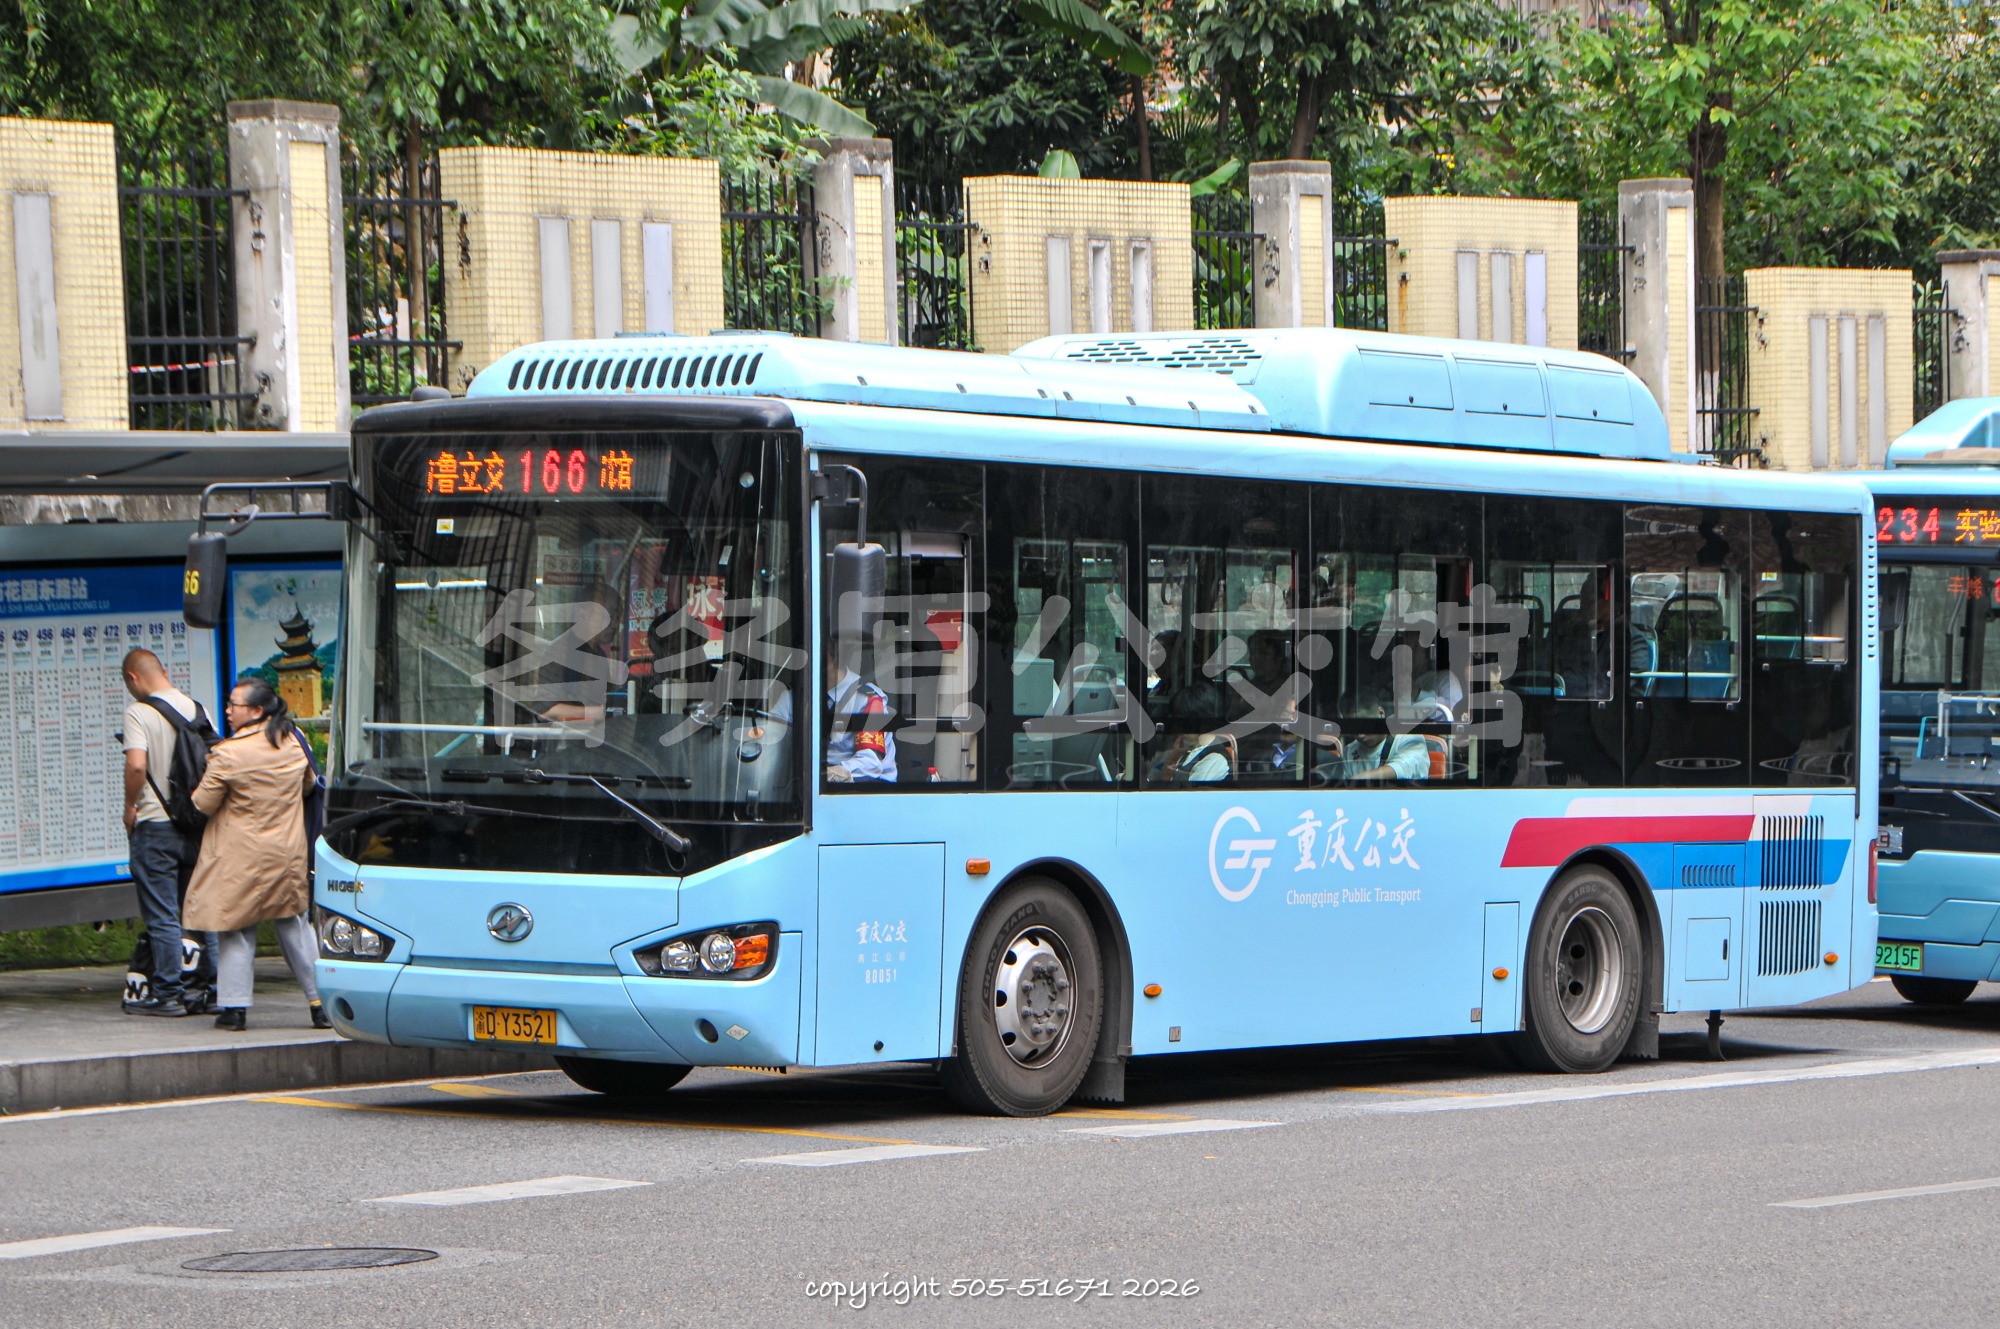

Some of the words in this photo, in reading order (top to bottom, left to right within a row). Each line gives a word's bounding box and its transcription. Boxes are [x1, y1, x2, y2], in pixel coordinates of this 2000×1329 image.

[520, 450, 587, 493] 166
[1877, 507, 1940, 542] 234
[1287, 808, 1421, 872] 重庆公交
[1286, 889, 1339, 908] Chongqing
[1342, 887, 1372, 903] Public
[1374, 887, 1421, 905] Transport
[855, 919, 908, 945] 重庆公交
